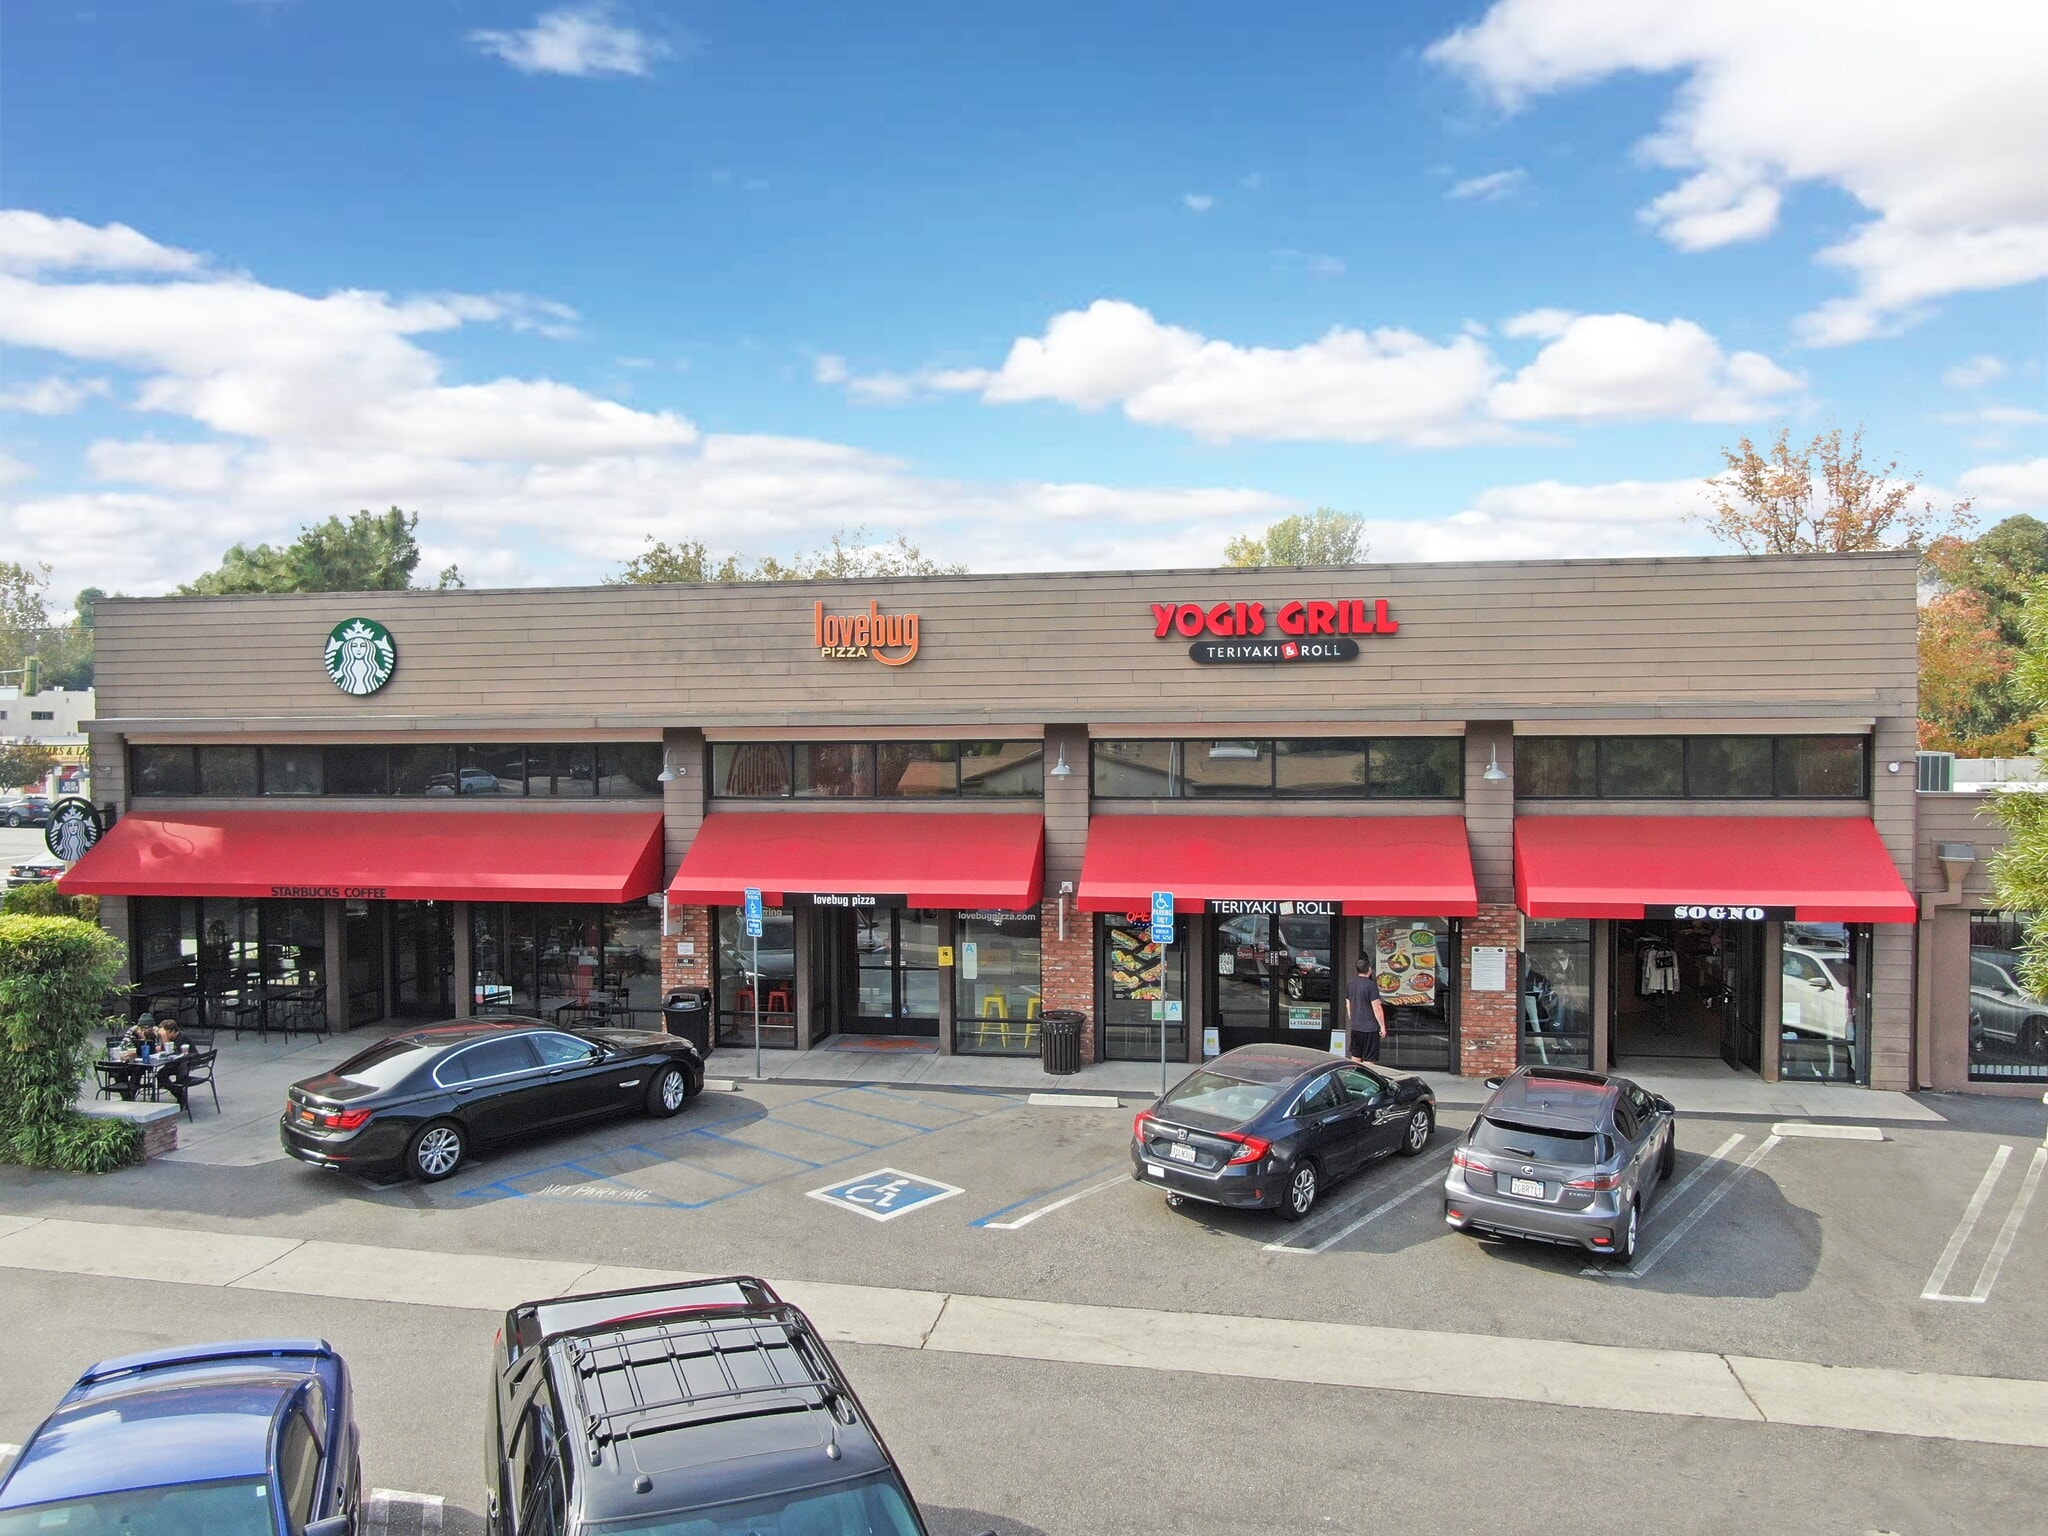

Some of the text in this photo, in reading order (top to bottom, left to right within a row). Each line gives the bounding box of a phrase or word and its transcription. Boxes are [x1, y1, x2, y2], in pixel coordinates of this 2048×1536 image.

[1150, 600, 1399, 637] YOGIS GRILL
[815, 600, 919, 665] lovebug
[821, 647, 868, 658] PIZZA
[1206, 644, 1341, 658] TERIYAKI & ROLL
[271, 886, 386, 898] STARBUCKS COFFEE
[813, 894, 876, 907] lovebug pizza
[1212, 901, 1336, 915] TERIYAKI ROLL
[1674, 906, 1764, 920] SOGNO
[958, 912, 1036, 922] lovebugpizza.com
[965, 943, 974, 953] A
[1169, 1002, 1178, 1012] A
[540, 1184, 652, 1201] NO PARKING
